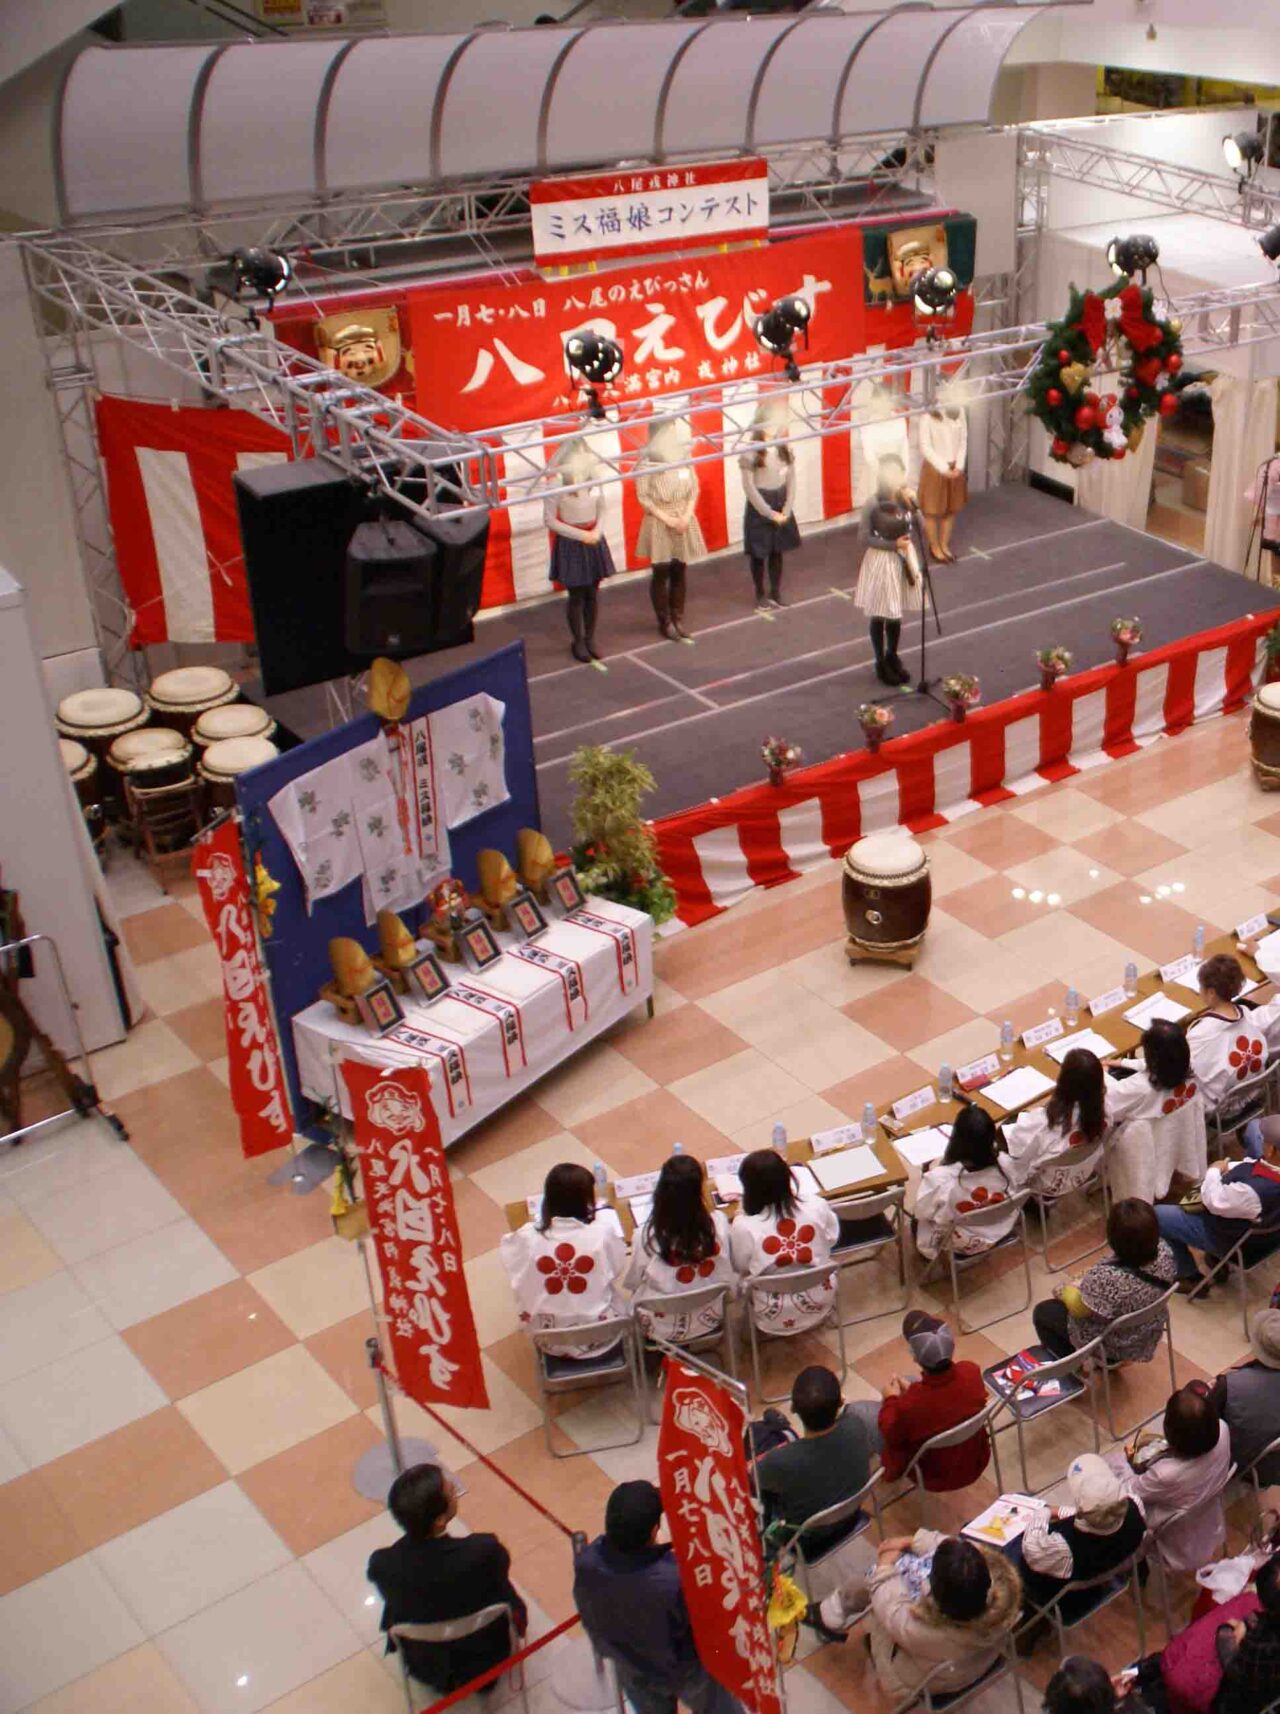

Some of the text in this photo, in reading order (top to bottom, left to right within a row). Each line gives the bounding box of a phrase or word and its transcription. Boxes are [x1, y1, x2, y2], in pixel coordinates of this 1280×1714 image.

[613, 171, 697, 193] 八尾戎神社
[549, 192, 758, 239] ミス福娘コンテスト
[433, 270, 710, 327] 一月七・八日 八尾のえびっさん
[664, 1449, 713, 1588] 一月七・八日
